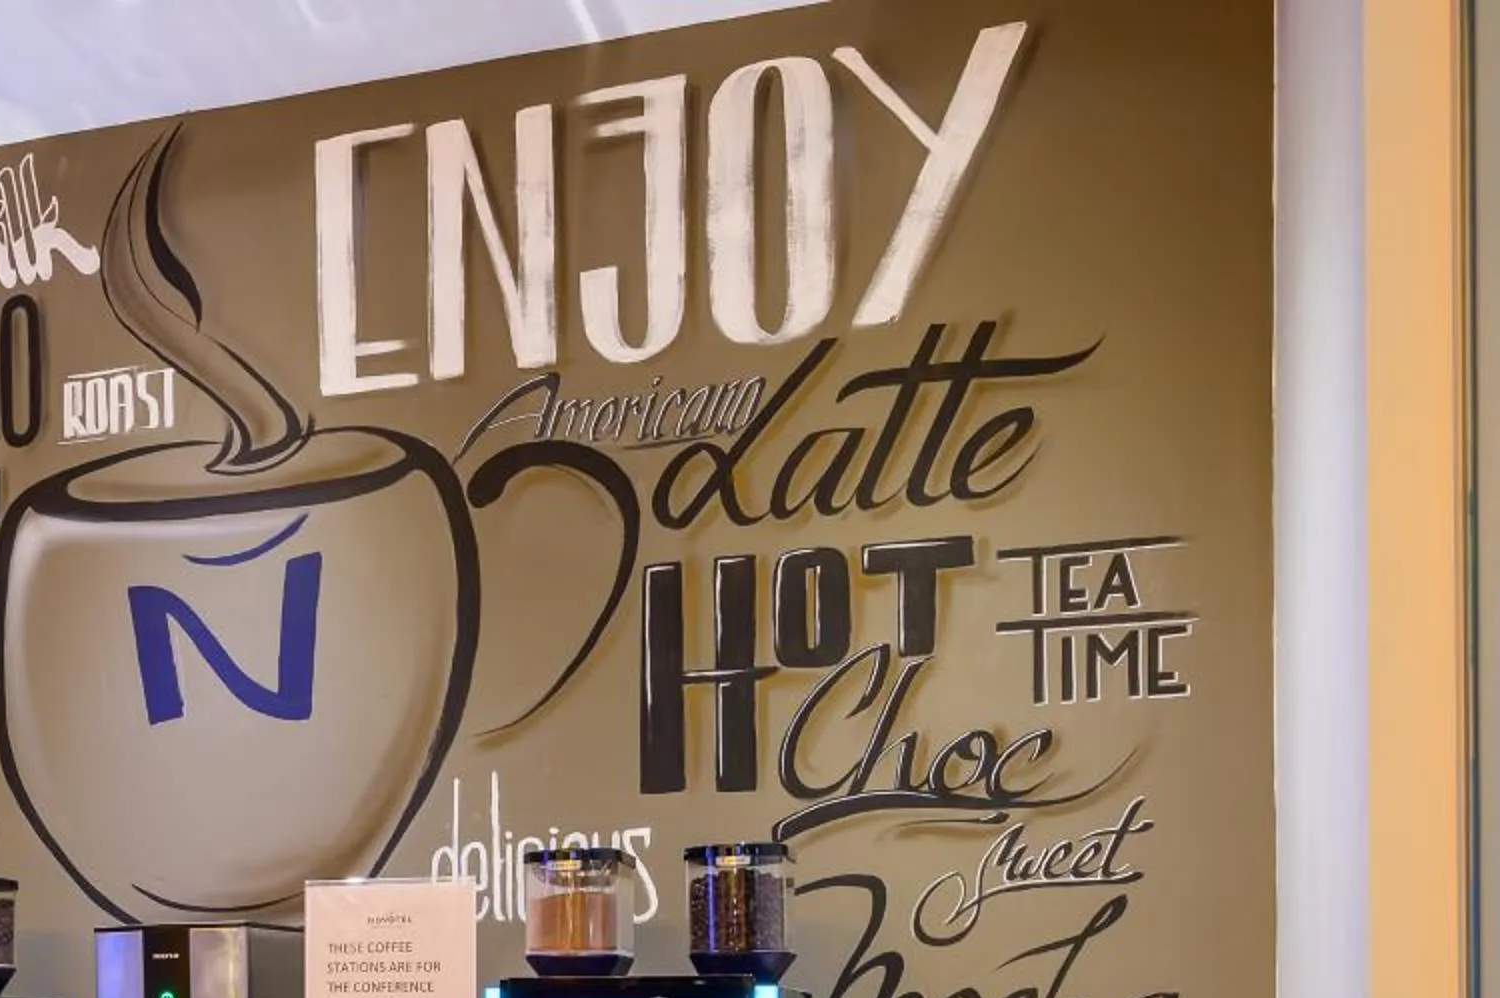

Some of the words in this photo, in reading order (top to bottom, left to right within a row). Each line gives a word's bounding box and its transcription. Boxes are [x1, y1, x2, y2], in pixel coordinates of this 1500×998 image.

[313, 20, 1028, 397] ENJOY
[59, 366, 176, 444] ROAST
[652, 319, 1104, 528] Latte
[996, 538, 1164, 614] TEA
[639, 535, 975, 794] HOT
[996, 616, 1197, 706] TIME
[775, 643, 1100, 822] Choc
[327, 962, 387, 974] STATIONS
[389, 961, 413, 973] ARE
[415, 961, 442, 973] FOR
[327, 981, 351, 993] THE
[353, 981, 435, 993] CONFERENCE
[328, 942, 363, 953] THESE
[366, 941, 413, 953] COFFEE
